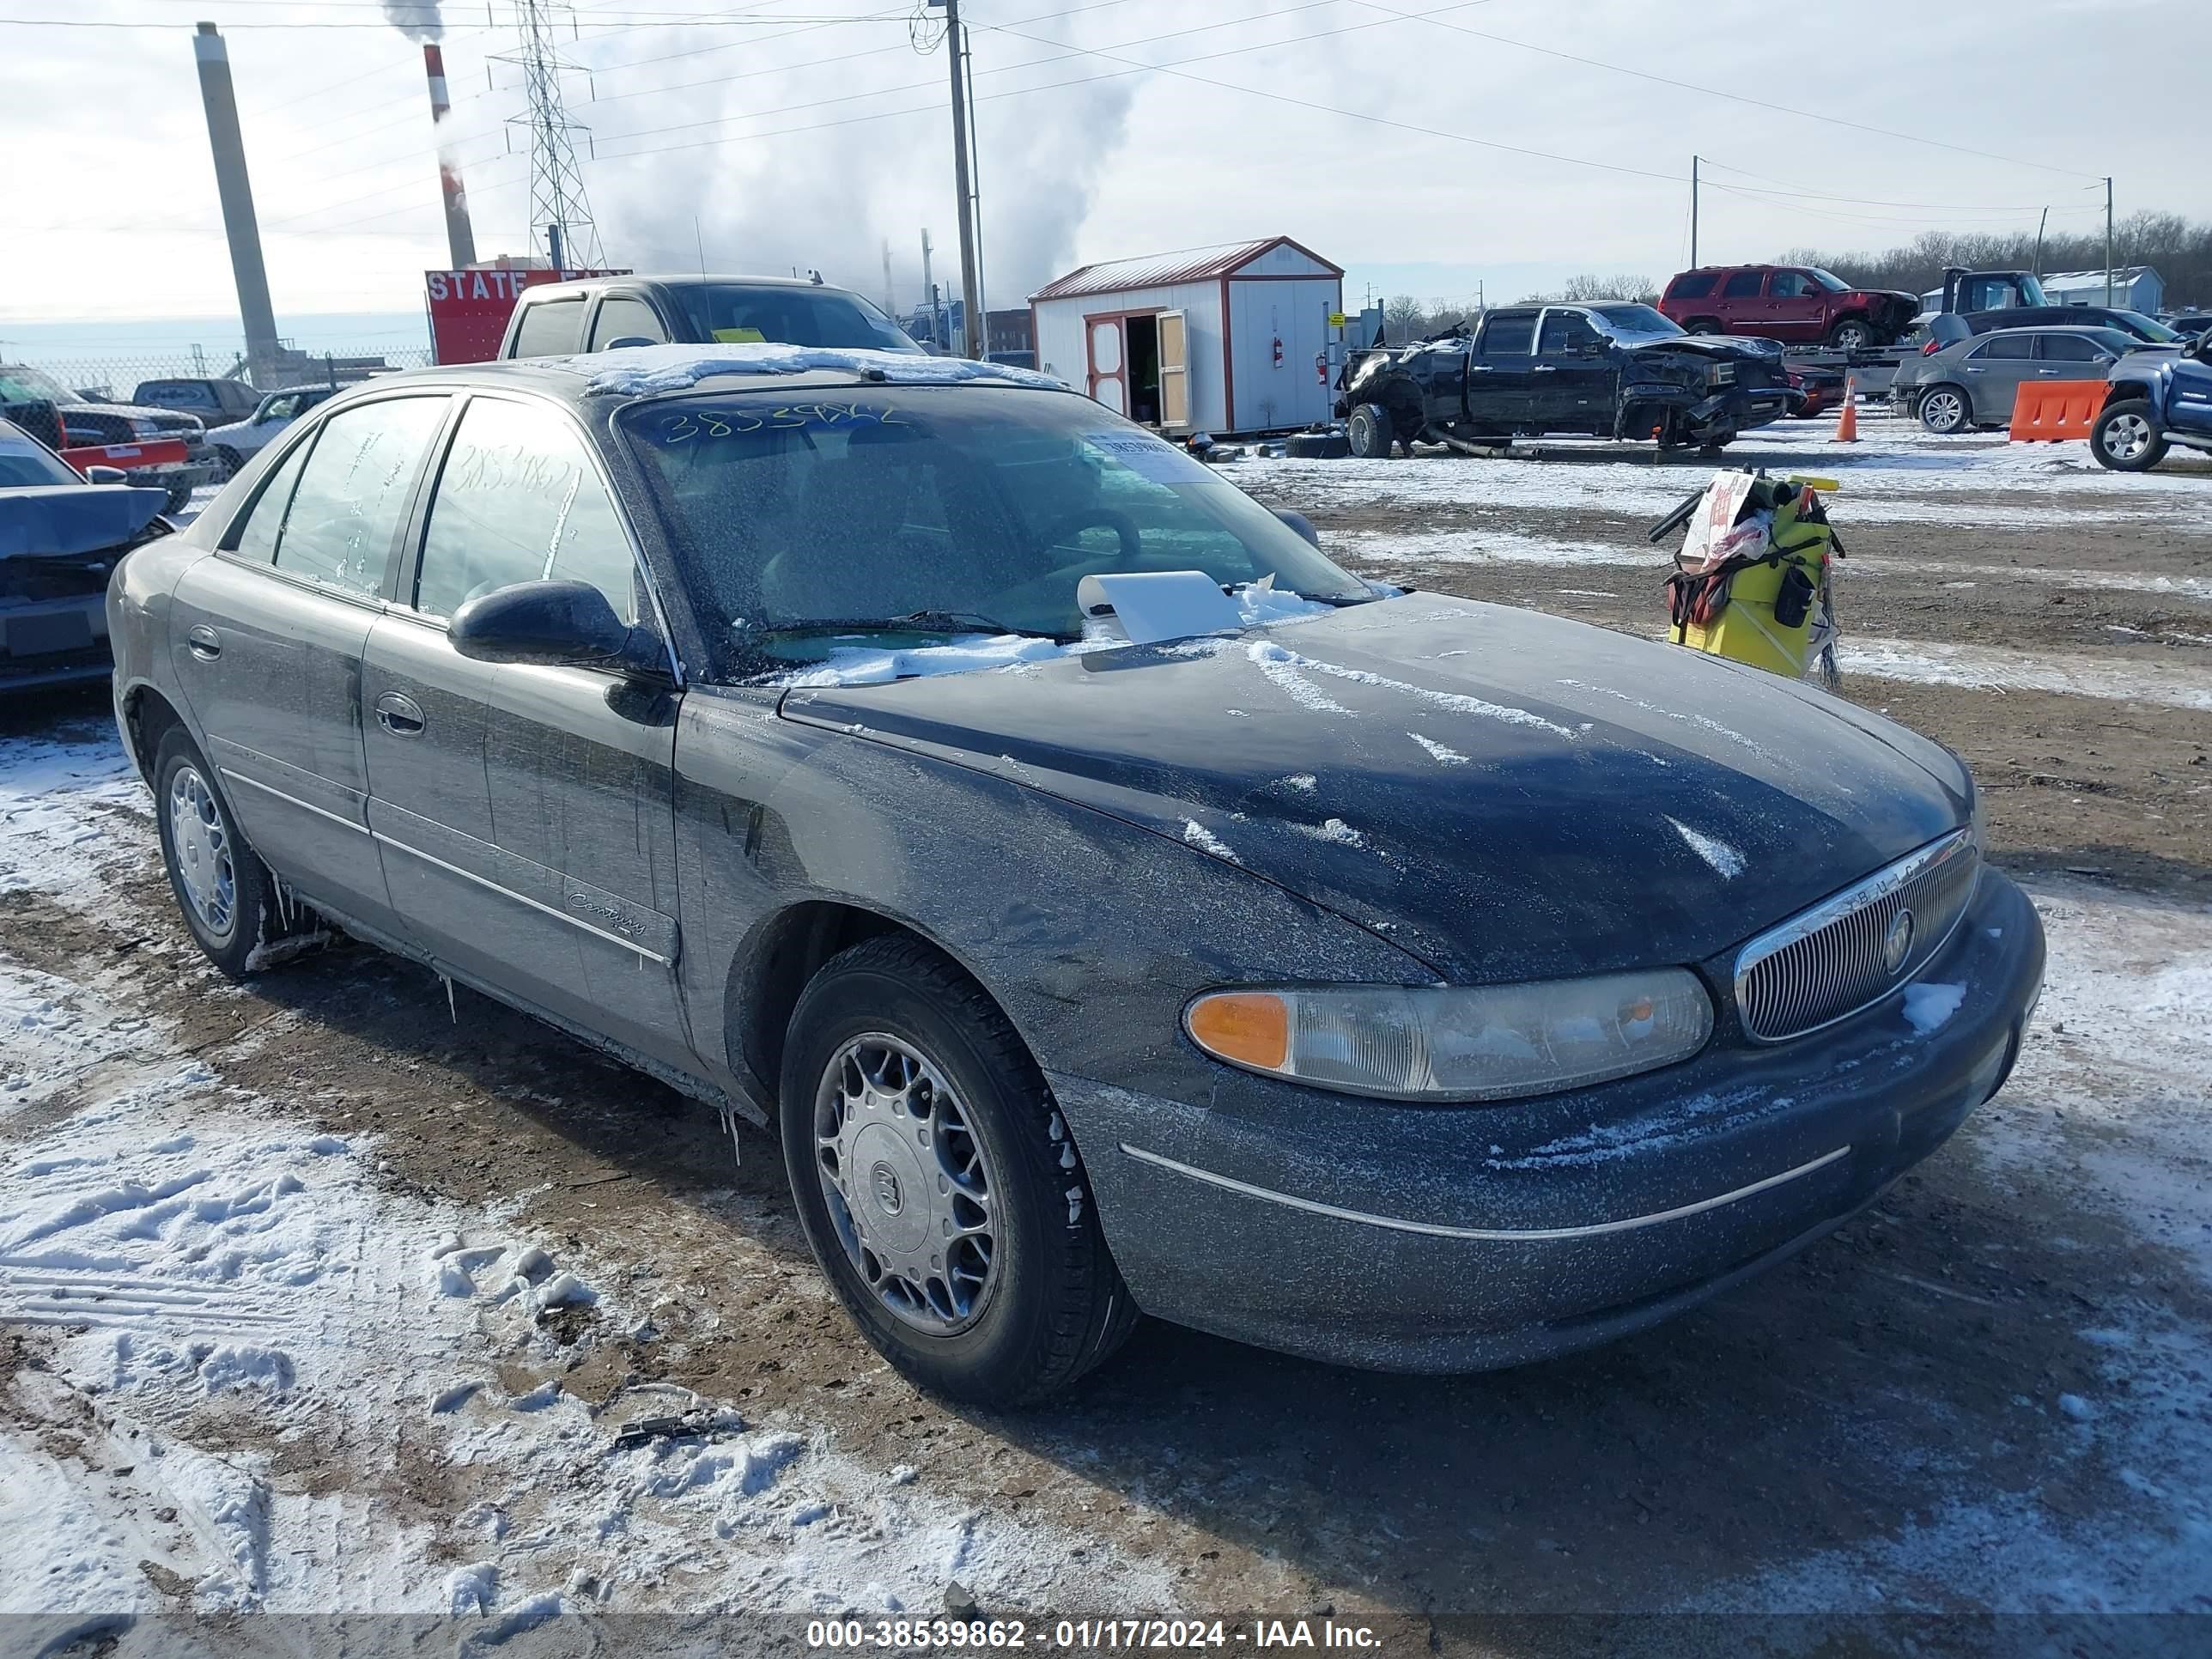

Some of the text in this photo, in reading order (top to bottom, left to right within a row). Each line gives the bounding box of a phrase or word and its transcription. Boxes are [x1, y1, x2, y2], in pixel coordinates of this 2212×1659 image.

[428, 271, 527, 301] STATE
[1105, 441, 1173, 453] 38539862
[1857, 857, 1928, 904] BUICK
[568, 892, 647, 936] Century
